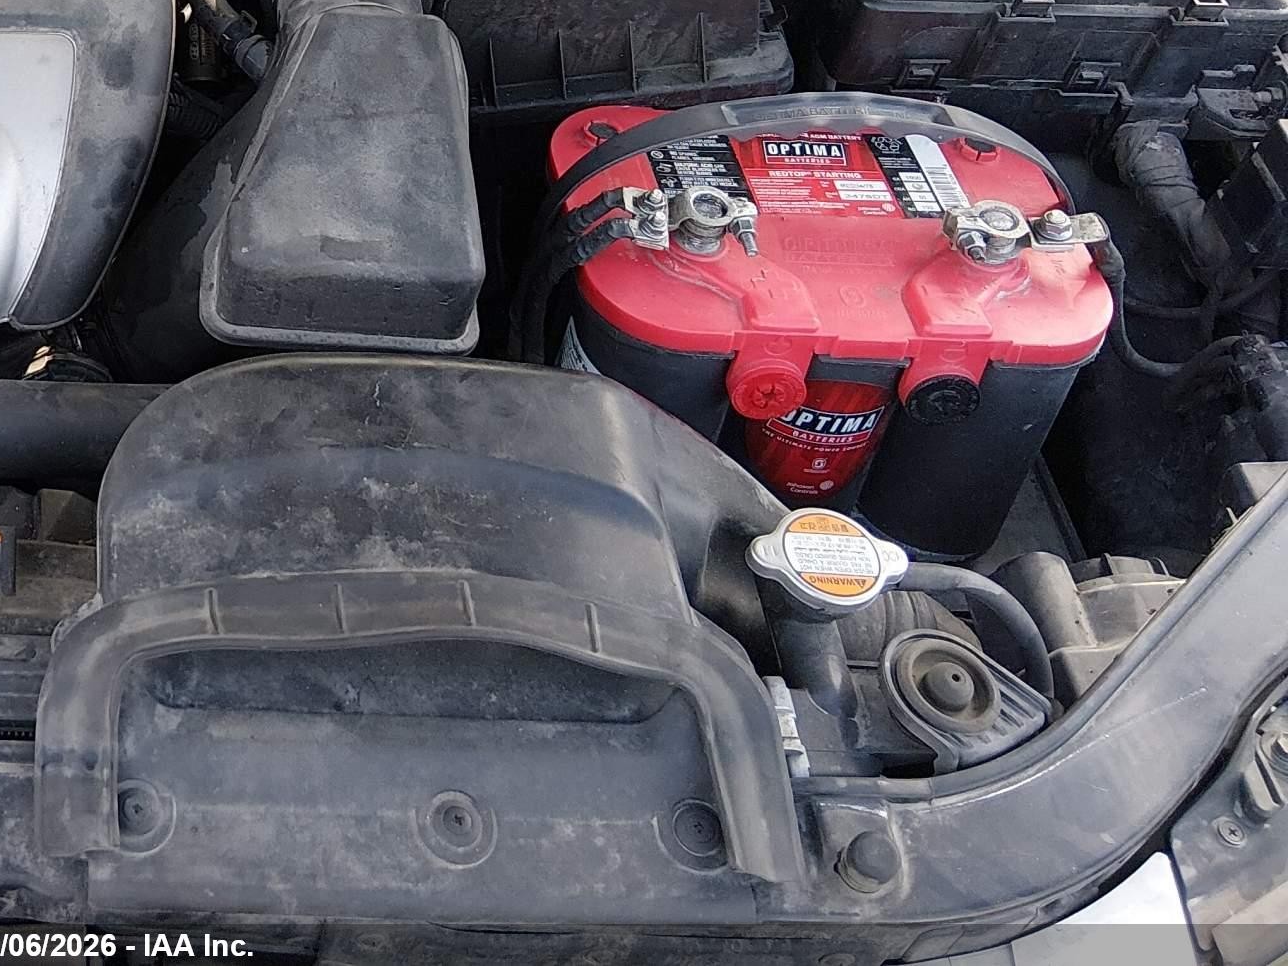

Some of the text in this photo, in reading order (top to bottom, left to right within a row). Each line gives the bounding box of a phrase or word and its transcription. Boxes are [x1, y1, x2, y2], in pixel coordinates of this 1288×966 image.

[767, 143, 842, 157] OPTIMA
[813, 171, 862, 179] STARTING
[777, 436, 811, 450] ULTIMATE
[792, 430, 853, 443] BATTERIES
[809, 575, 854, 586] WARNING
